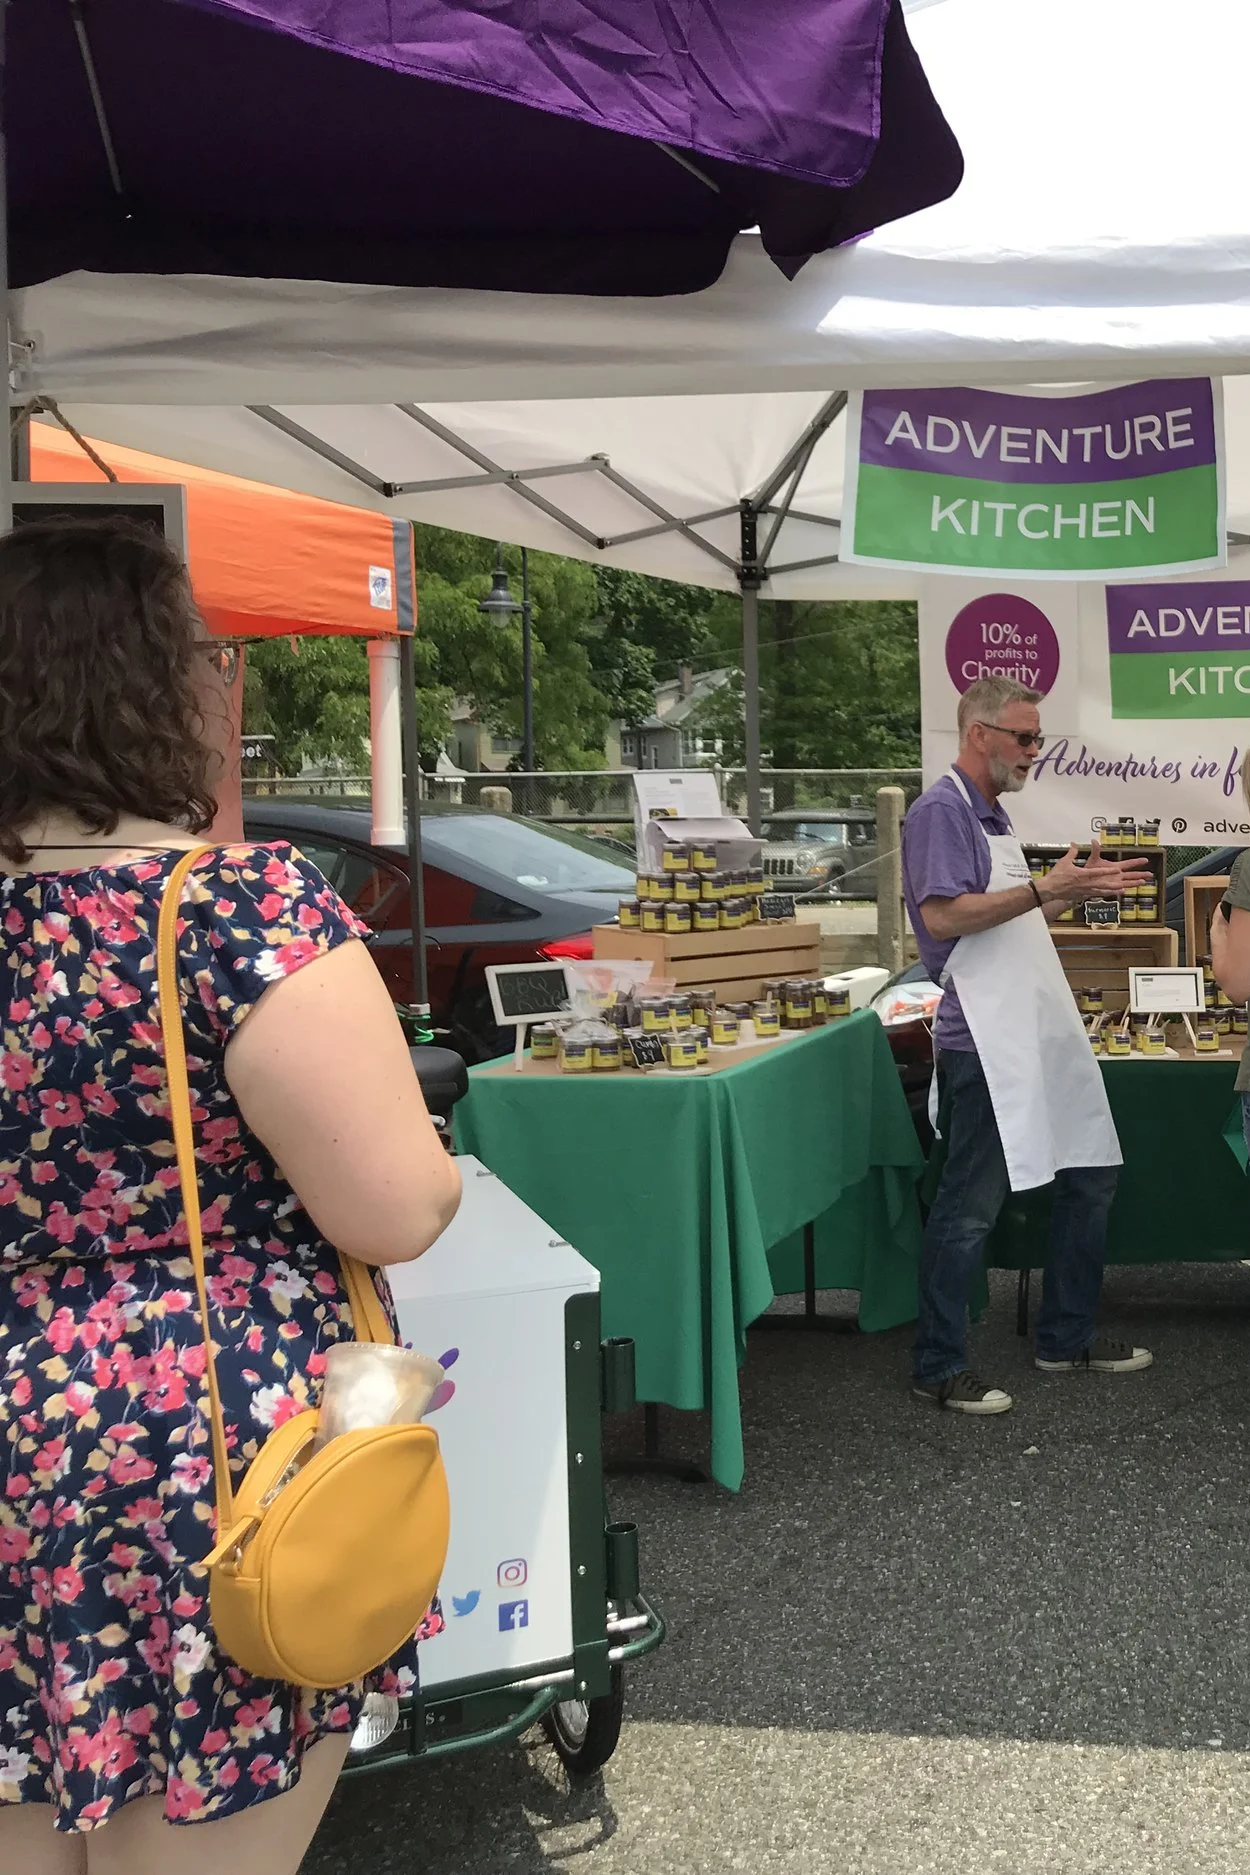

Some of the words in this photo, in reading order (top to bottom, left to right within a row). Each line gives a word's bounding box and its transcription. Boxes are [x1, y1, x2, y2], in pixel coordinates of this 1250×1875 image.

[884, 406, 1195, 464] ADVENTURE
[930, 495, 1156, 539] KITCHEN
[980, 622, 1022, 645] 10%
[1024, 633, 1038, 645] of
[984, 647, 1023, 660] profits
[1025, 648, 1038, 660] to
[961, 660, 1040, 687] Charity
[1032, 738, 1182, 784] Adventures
[1190, 754, 1221, 780] in
